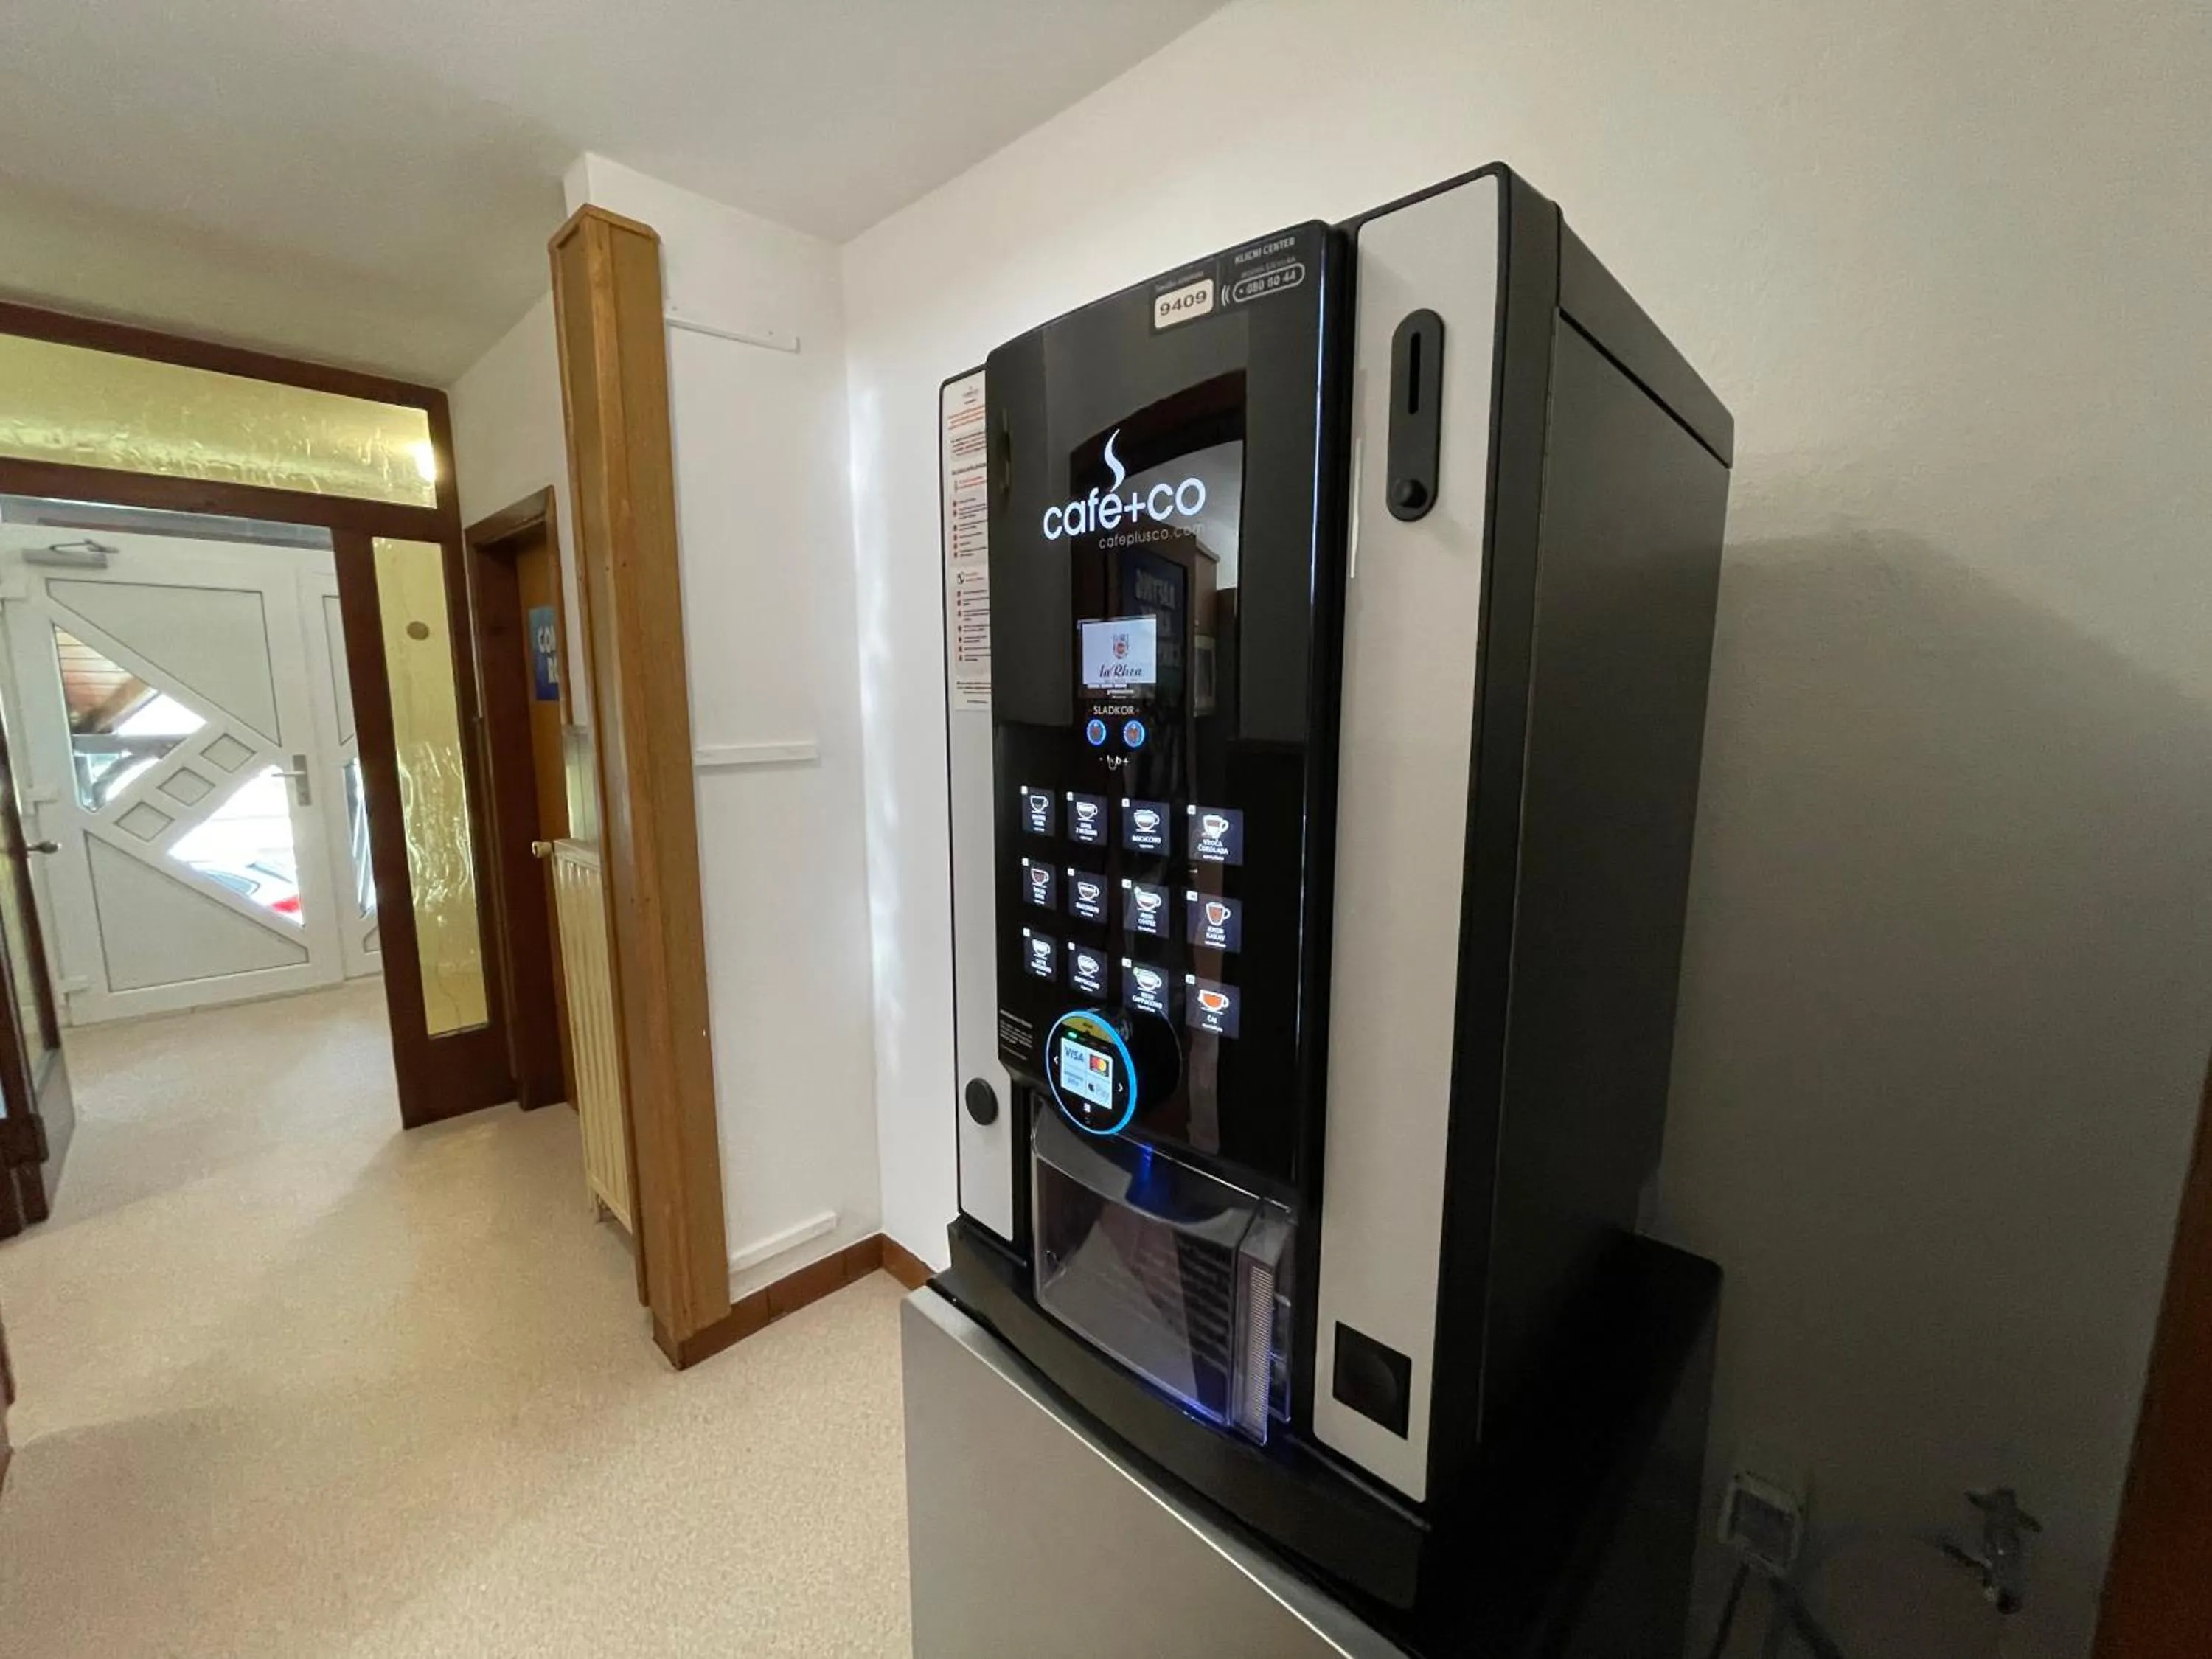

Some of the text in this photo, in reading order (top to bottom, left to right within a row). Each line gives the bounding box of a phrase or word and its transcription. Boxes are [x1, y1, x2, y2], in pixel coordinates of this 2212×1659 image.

[1263, 237, 1295, 254] CENTER
[1159, 291, 1207, 316] 9409
[1093, 705, 1135, 715] SLADKOR
[1064, 1045, 1084, 1062] VISA
